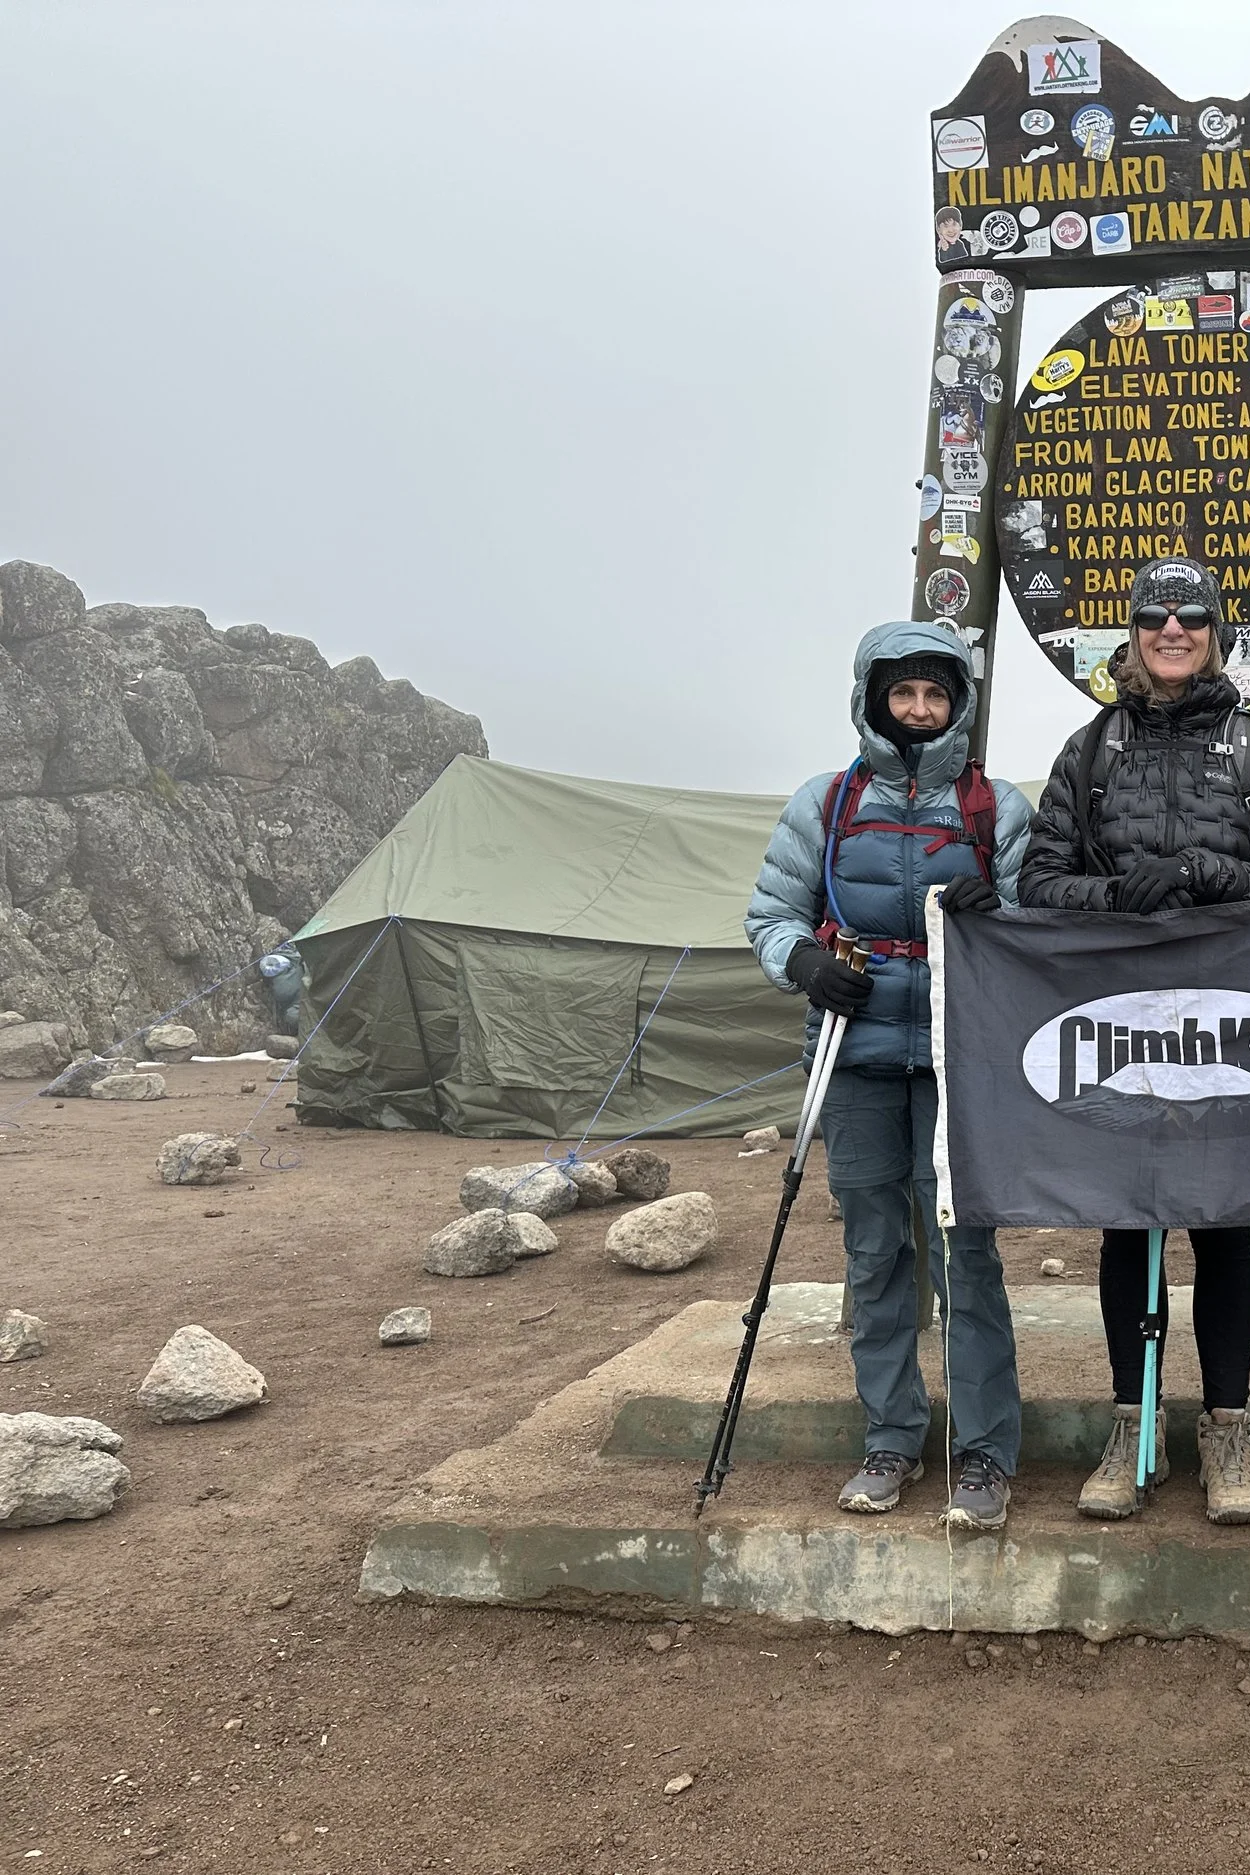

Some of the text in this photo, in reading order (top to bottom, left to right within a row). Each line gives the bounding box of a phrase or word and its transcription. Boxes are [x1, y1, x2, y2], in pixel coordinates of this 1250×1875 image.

[947, 155, 1166, 207] KILIMANJARO
[1089, 336, 1150, 368] LAVA
[1163, 331, 1249, 364] TOWER
[1081, 370, 1242, 399] ELEVATION:
[1023, 405, 1151, 434] VEGETATION
[950, 451, 979, 459] VICE
[1016, 438, 1094, 467] FROM
[1105, 436, 1173, 464] LAVA
[953, 472, 979, 480] GYM
[1016, 471, 1093, 499] ARROW
[1105, 468, 1214, 497] GLACIER
[1066, 500, 1186, 530] BARANCO
[1068, 533, 1189, 560] KARANGA
[1079, 599, 1132, 627] UHU
[943, 815, 963, 830] Rab
